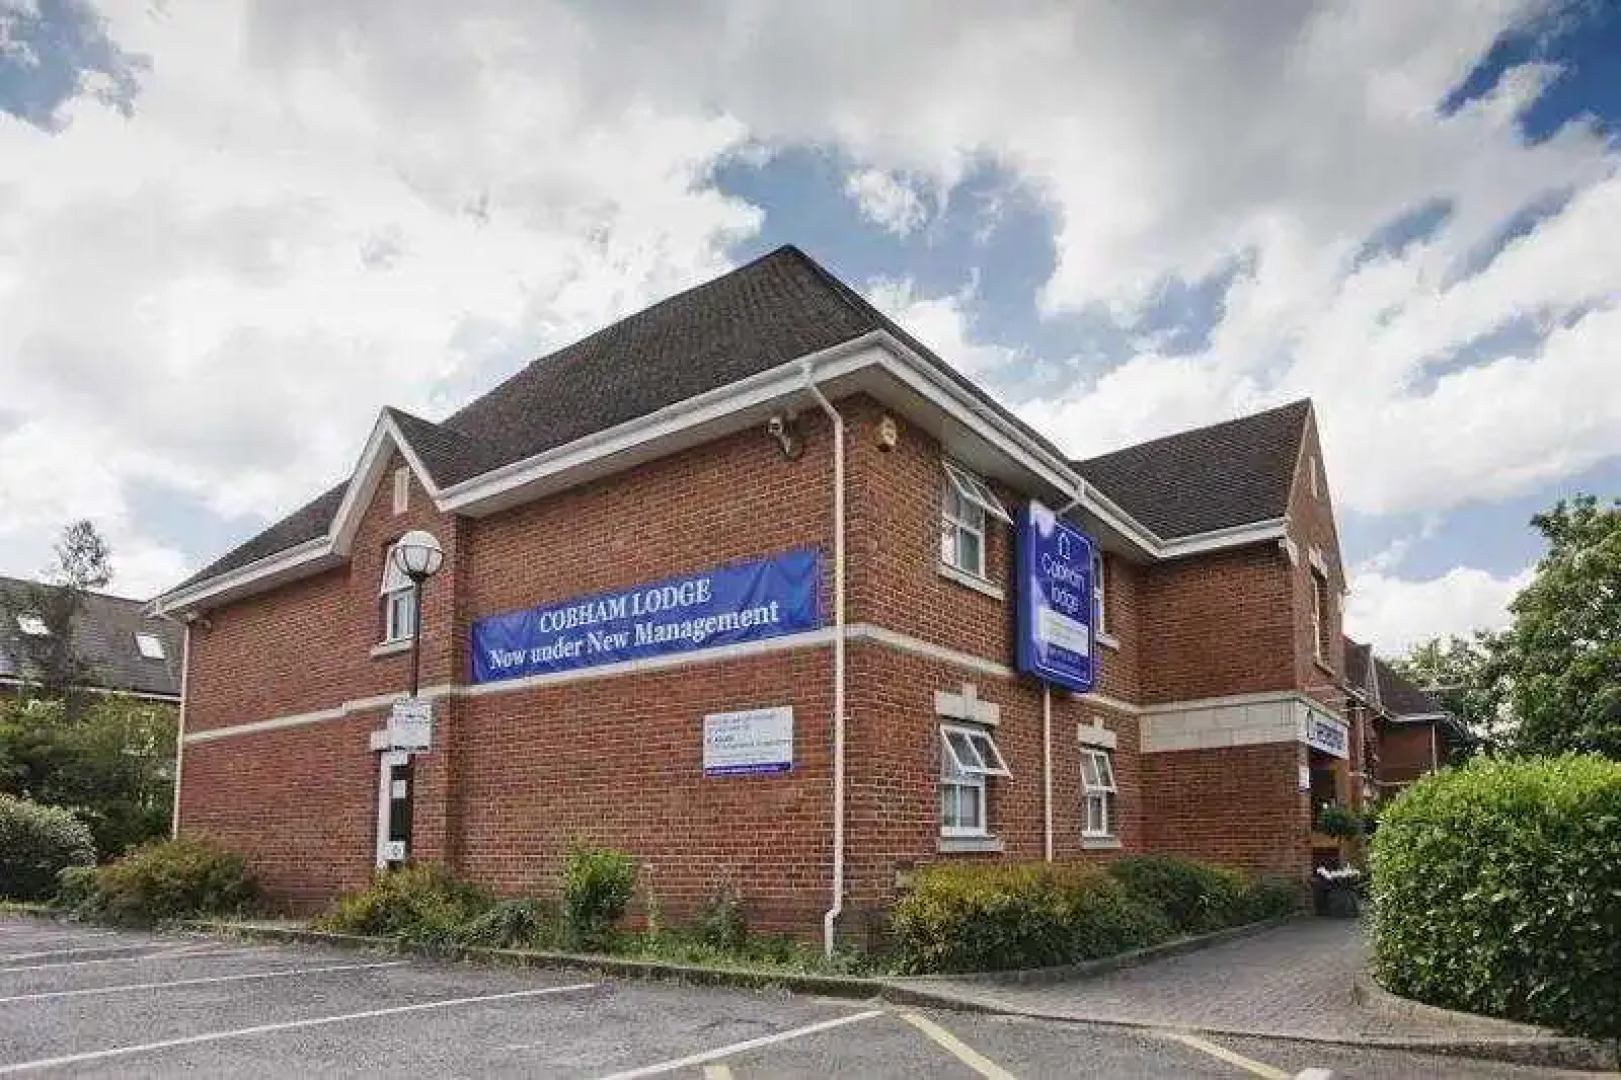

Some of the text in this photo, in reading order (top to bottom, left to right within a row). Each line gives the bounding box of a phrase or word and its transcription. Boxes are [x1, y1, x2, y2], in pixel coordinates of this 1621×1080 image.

[490, 600, 779, 669] Now under New Management
[540, 578, 712, 632] COBHAM LODGE
